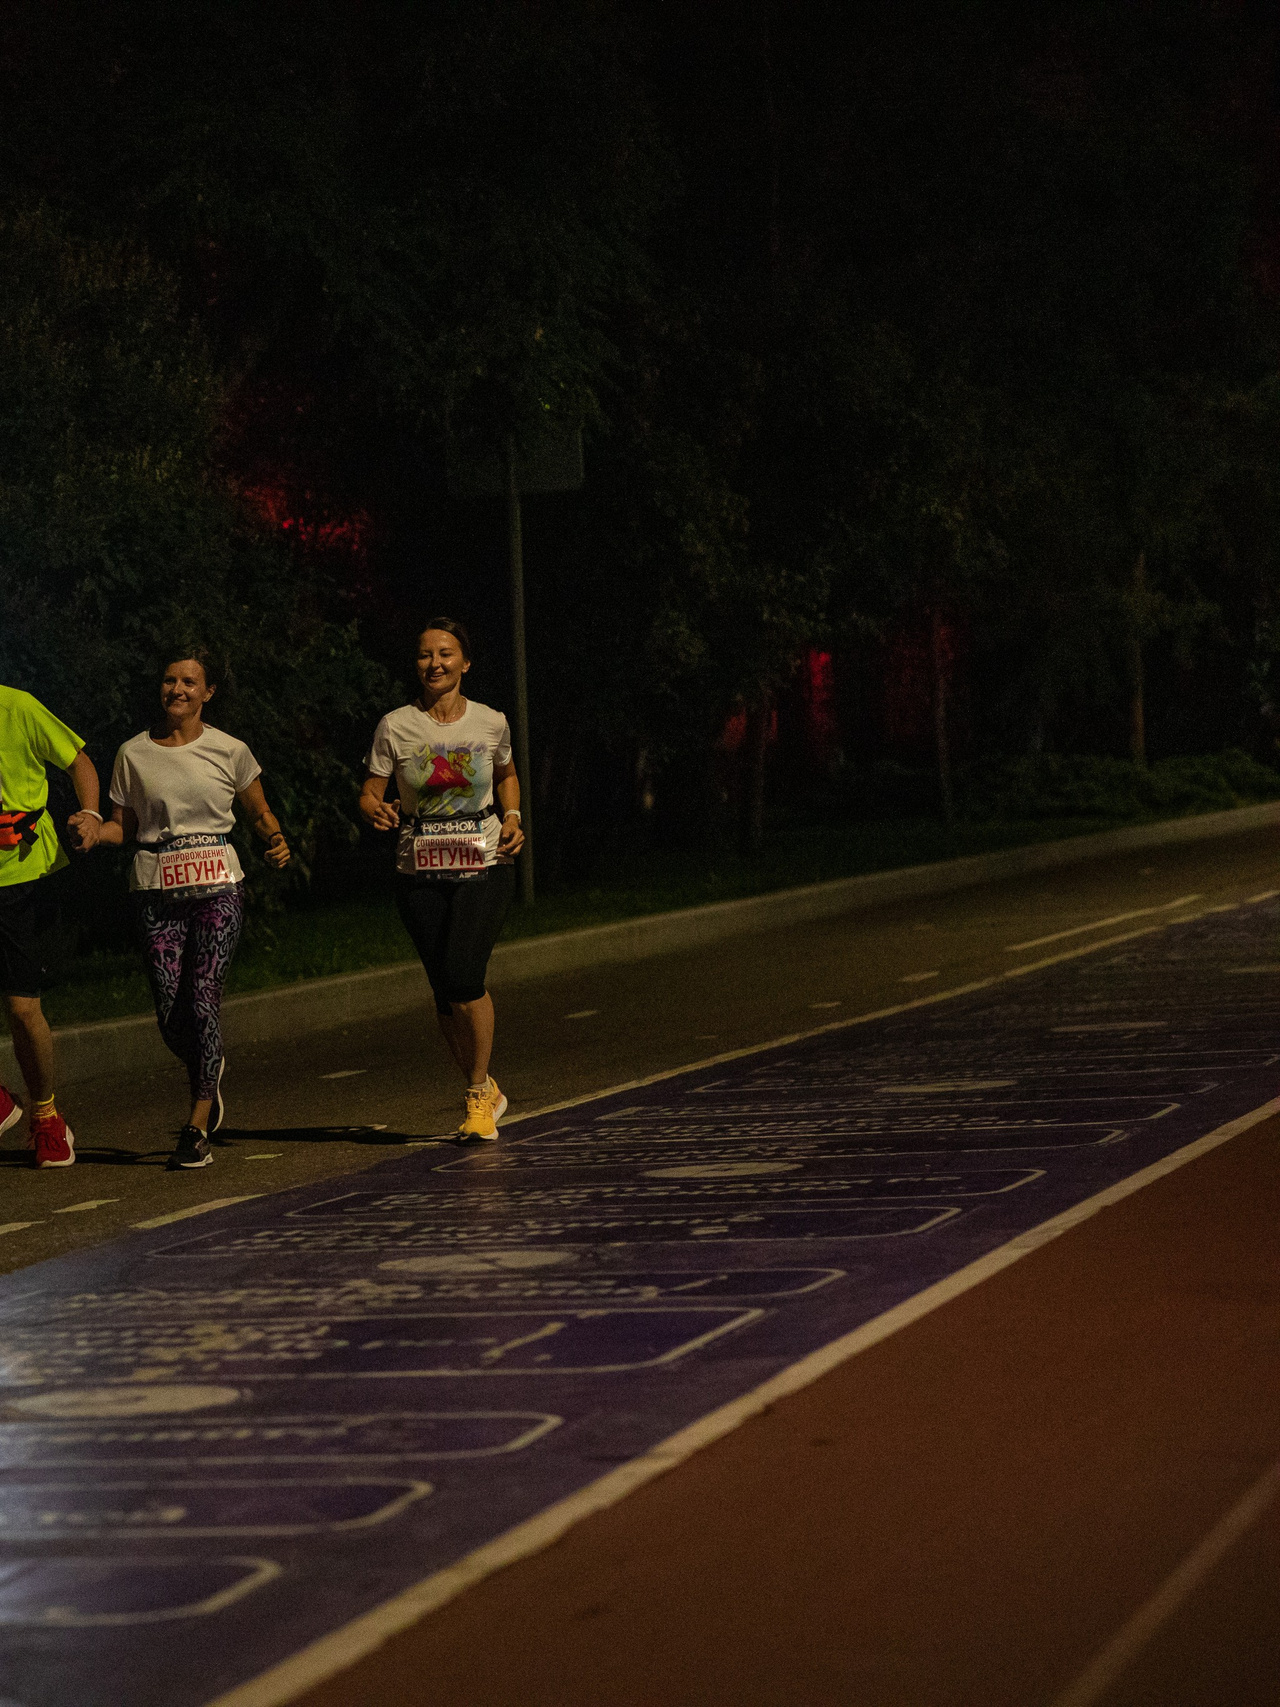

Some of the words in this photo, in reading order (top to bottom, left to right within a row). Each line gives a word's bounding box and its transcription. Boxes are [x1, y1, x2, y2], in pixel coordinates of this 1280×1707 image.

[162, 849, 225, 865] СОПРОВОЖДЕНИЕ
[418, 848, 483, 867] БЕГУНА
[163, 860, 229, 886] БЕГУНА
